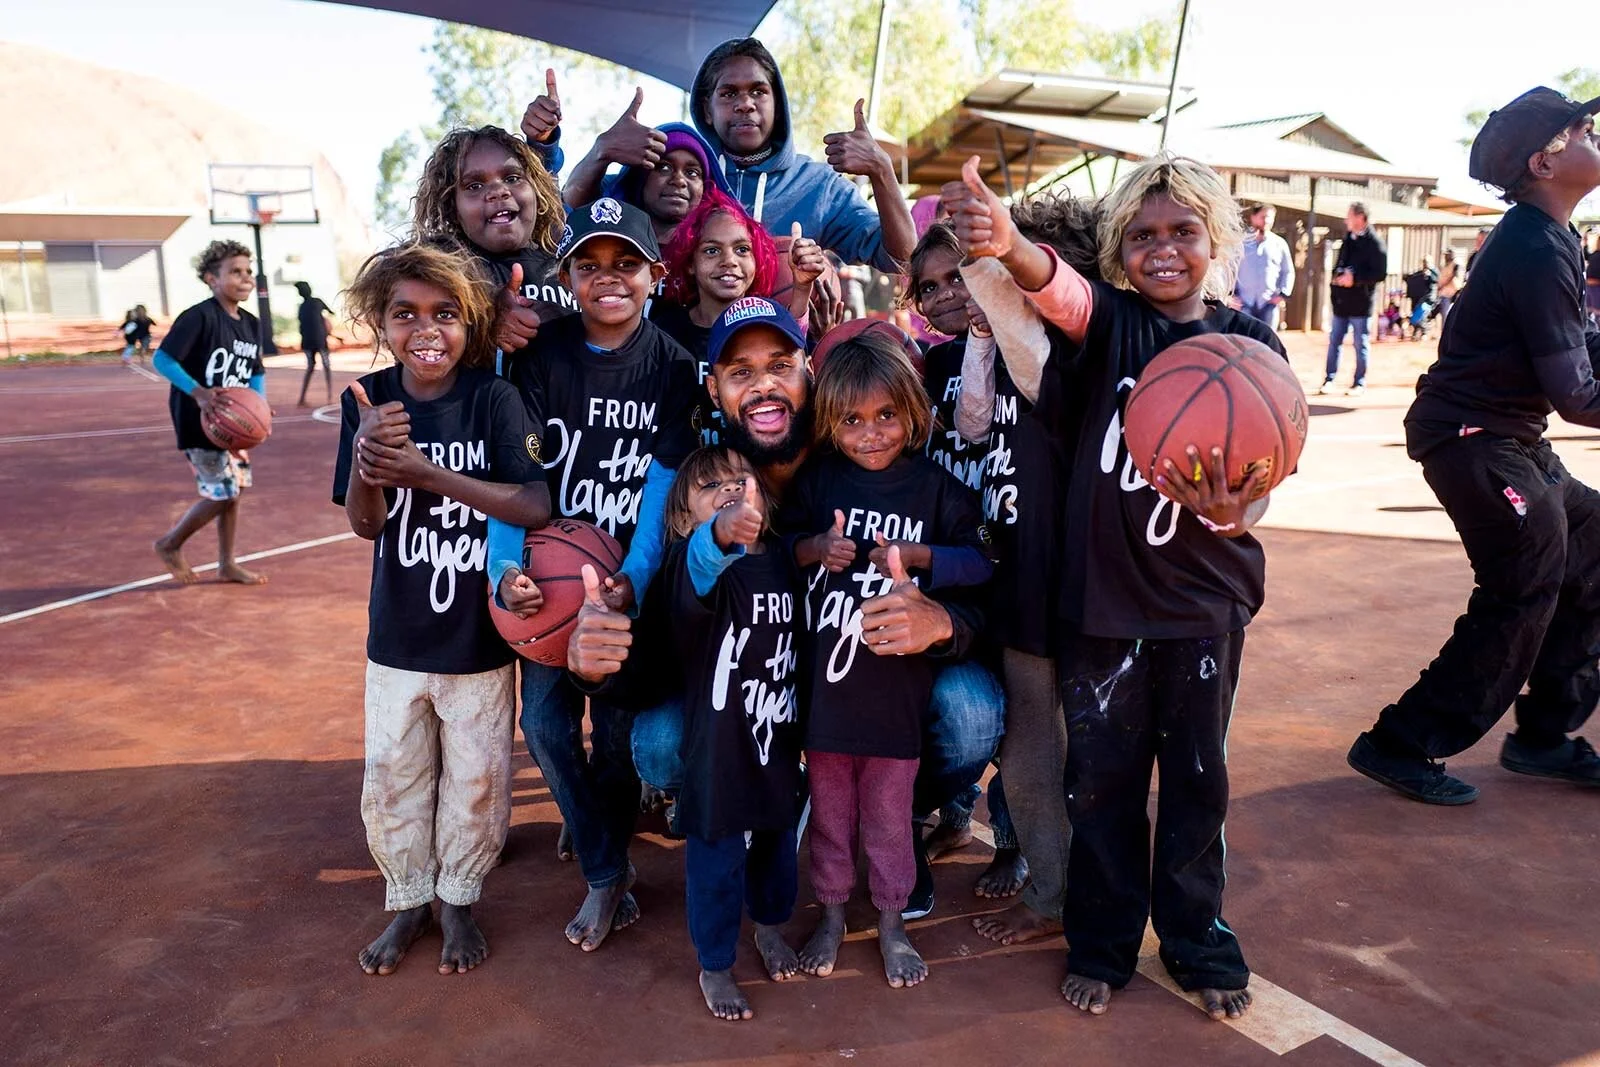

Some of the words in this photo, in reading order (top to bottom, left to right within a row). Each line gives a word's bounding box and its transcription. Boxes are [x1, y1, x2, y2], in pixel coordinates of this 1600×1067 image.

[726, 297, 772, 317] UNDER
[728, 306, 775, 323] ARMOUR
[588, 397, 658, 433] FROM,
[846, 508, 923, 543] FROM
[752, 593, 793, 624] FRO
